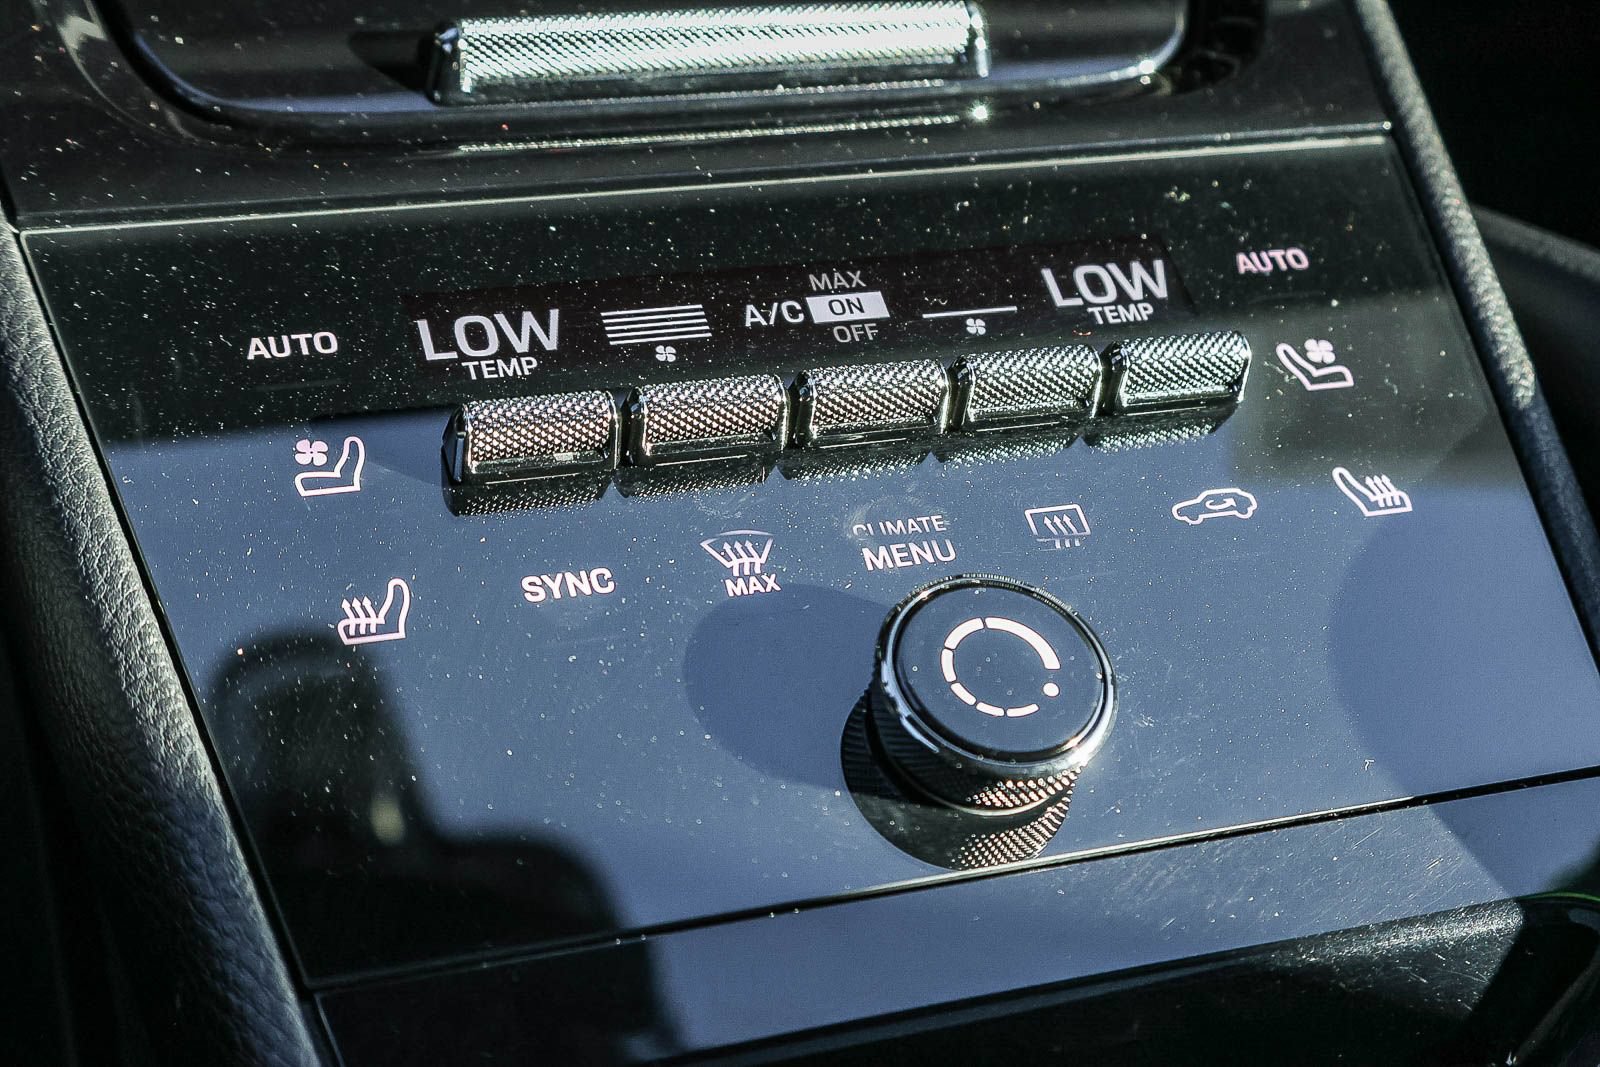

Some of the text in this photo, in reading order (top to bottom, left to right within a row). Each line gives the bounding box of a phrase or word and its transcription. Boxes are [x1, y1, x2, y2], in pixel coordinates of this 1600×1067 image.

[1236, 247, 1310, 275] AUTO
[808, 270, 867, 291] MAX
[1041, 259, 1168, 308] LOW
[744, 298, 865, 327] A/C ON
[1087, 302, 1154, 325] TEMP
[247, 331, 339, 360] AUTO
[417, 309, 560, 361] LOW
[833, 322, 878, 344] OFF
[462, 356, 539, 380] TEMP
[861, 538, 957, 571] MENU
[521, 567, 616, 603] SYNC
[724, 573, 782, 597] MAX
